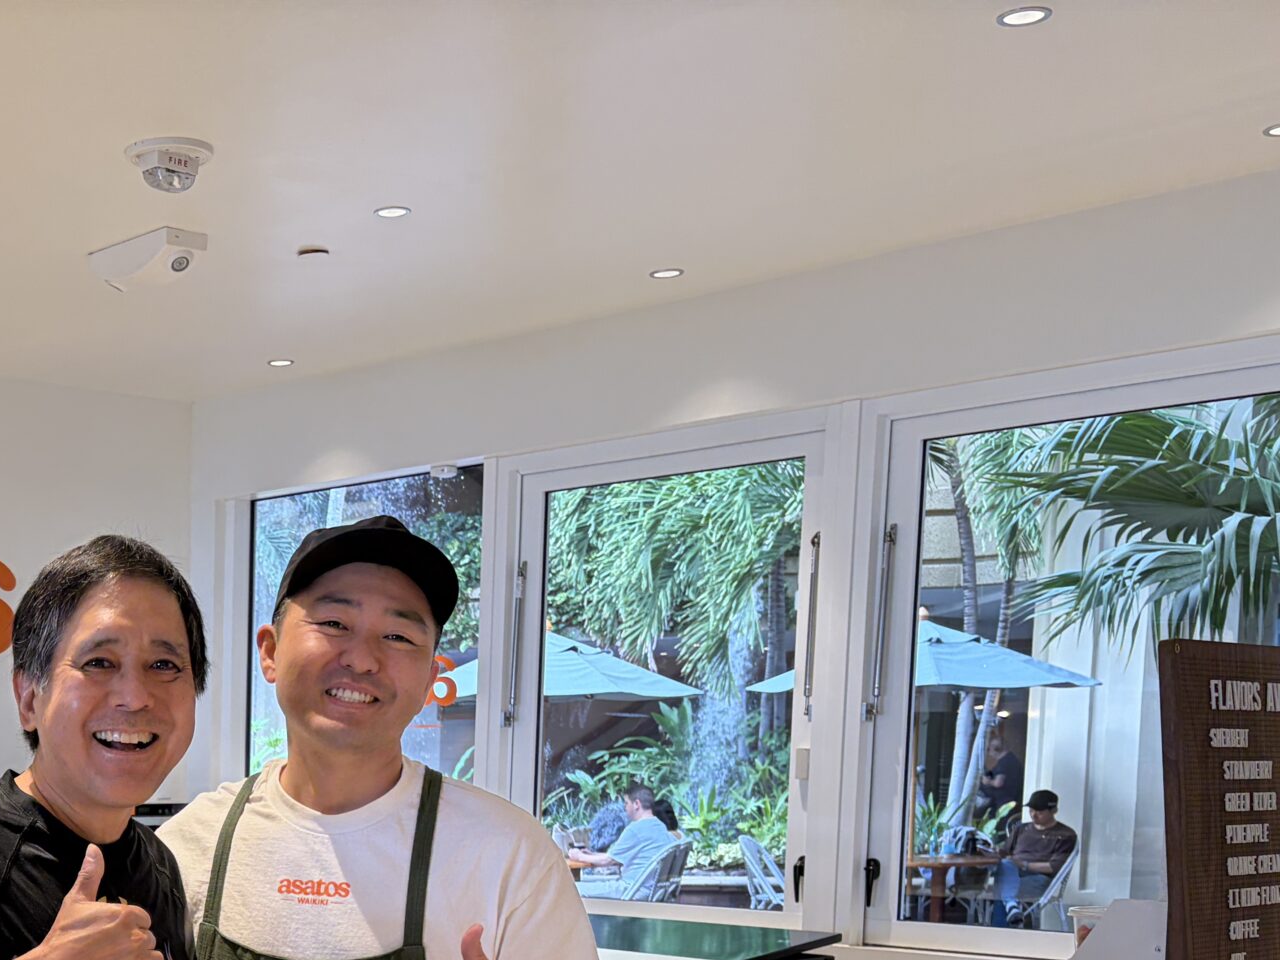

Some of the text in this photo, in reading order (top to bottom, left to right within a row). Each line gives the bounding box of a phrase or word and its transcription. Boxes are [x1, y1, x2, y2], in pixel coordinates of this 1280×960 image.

[168, 156, 188, 167] FIRE
[1209, 679, 1262, 711] FLAVORS
[1223, 760, 1273, 780] STRAWBERRY
[1225, 823, 1270, 844] PINEAPPLE
[1227, 855, 1257, 876] ORANGE
[277, 878, 351, 898] asatos
[297, 897, 329, 906] WAIKIKI
[1229, 918, 1260, 940] COFFEE
